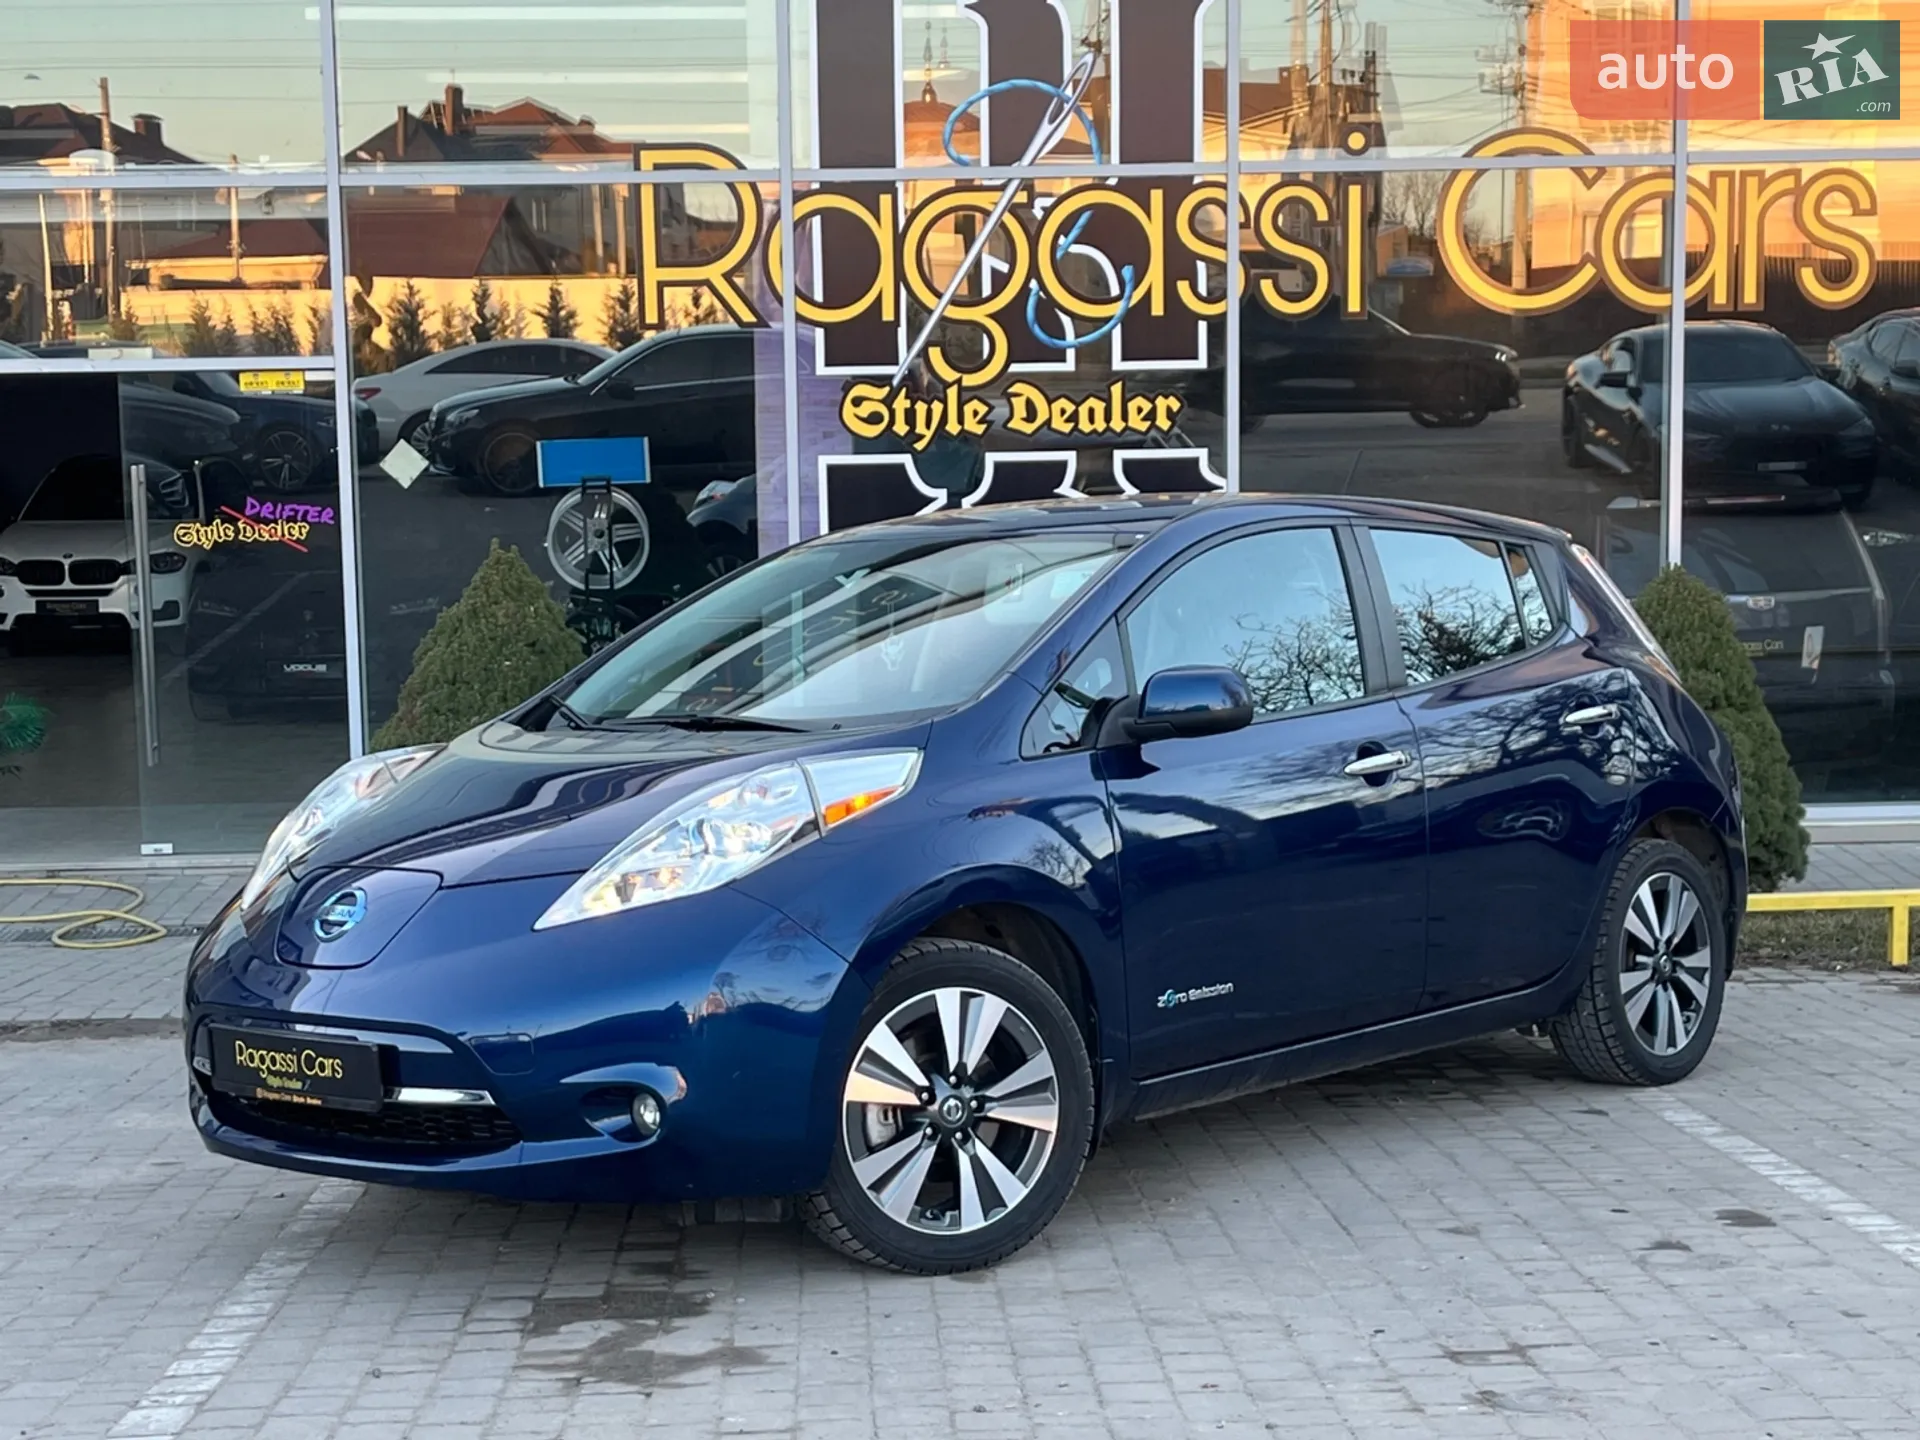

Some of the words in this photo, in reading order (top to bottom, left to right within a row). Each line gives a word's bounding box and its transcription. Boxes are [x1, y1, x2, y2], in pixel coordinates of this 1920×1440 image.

[634, 126, 1368, 391] Ragassi
[1437, 128, 1876, 316] Cars
[842, 379, 988, 450] Style
[1006, 379, 1182, 438] Dealer
[244, 496, 335, 525] DRIFTER
[174, 519, 235, 550] Style
[238, 519, 310, 543] Dealer
[234, 1040, 298, 1078] Ragassi
[300, 1049, 344, 1079] Cars
